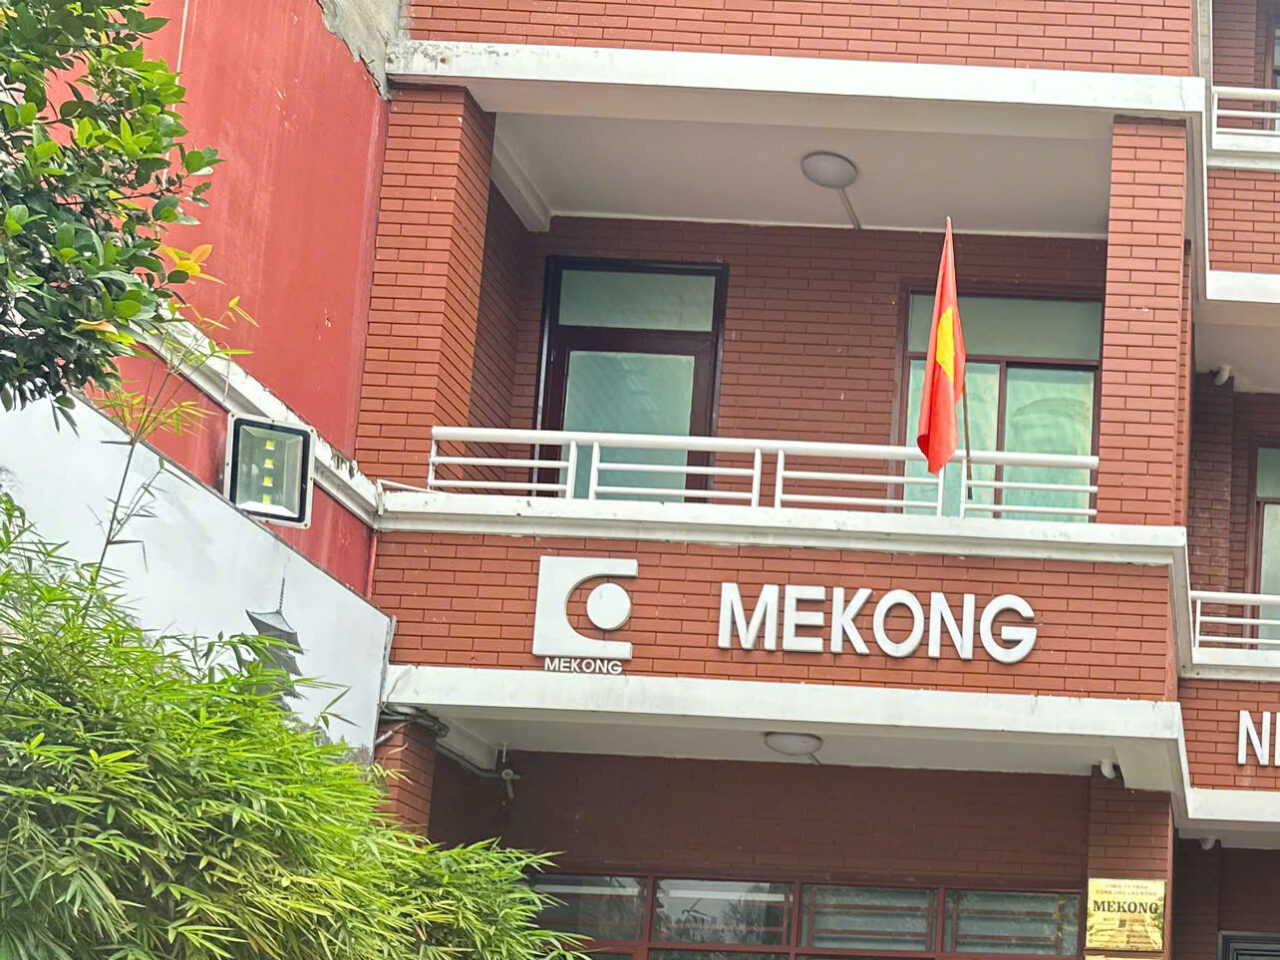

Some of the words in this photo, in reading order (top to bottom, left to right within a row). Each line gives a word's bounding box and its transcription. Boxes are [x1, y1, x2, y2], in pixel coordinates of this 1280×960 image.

[718, 582, 1037, 664] MEKONG
[544, 657, 623, 675] MEKONG
[1092, 900, 1159, 914] MEKONG
